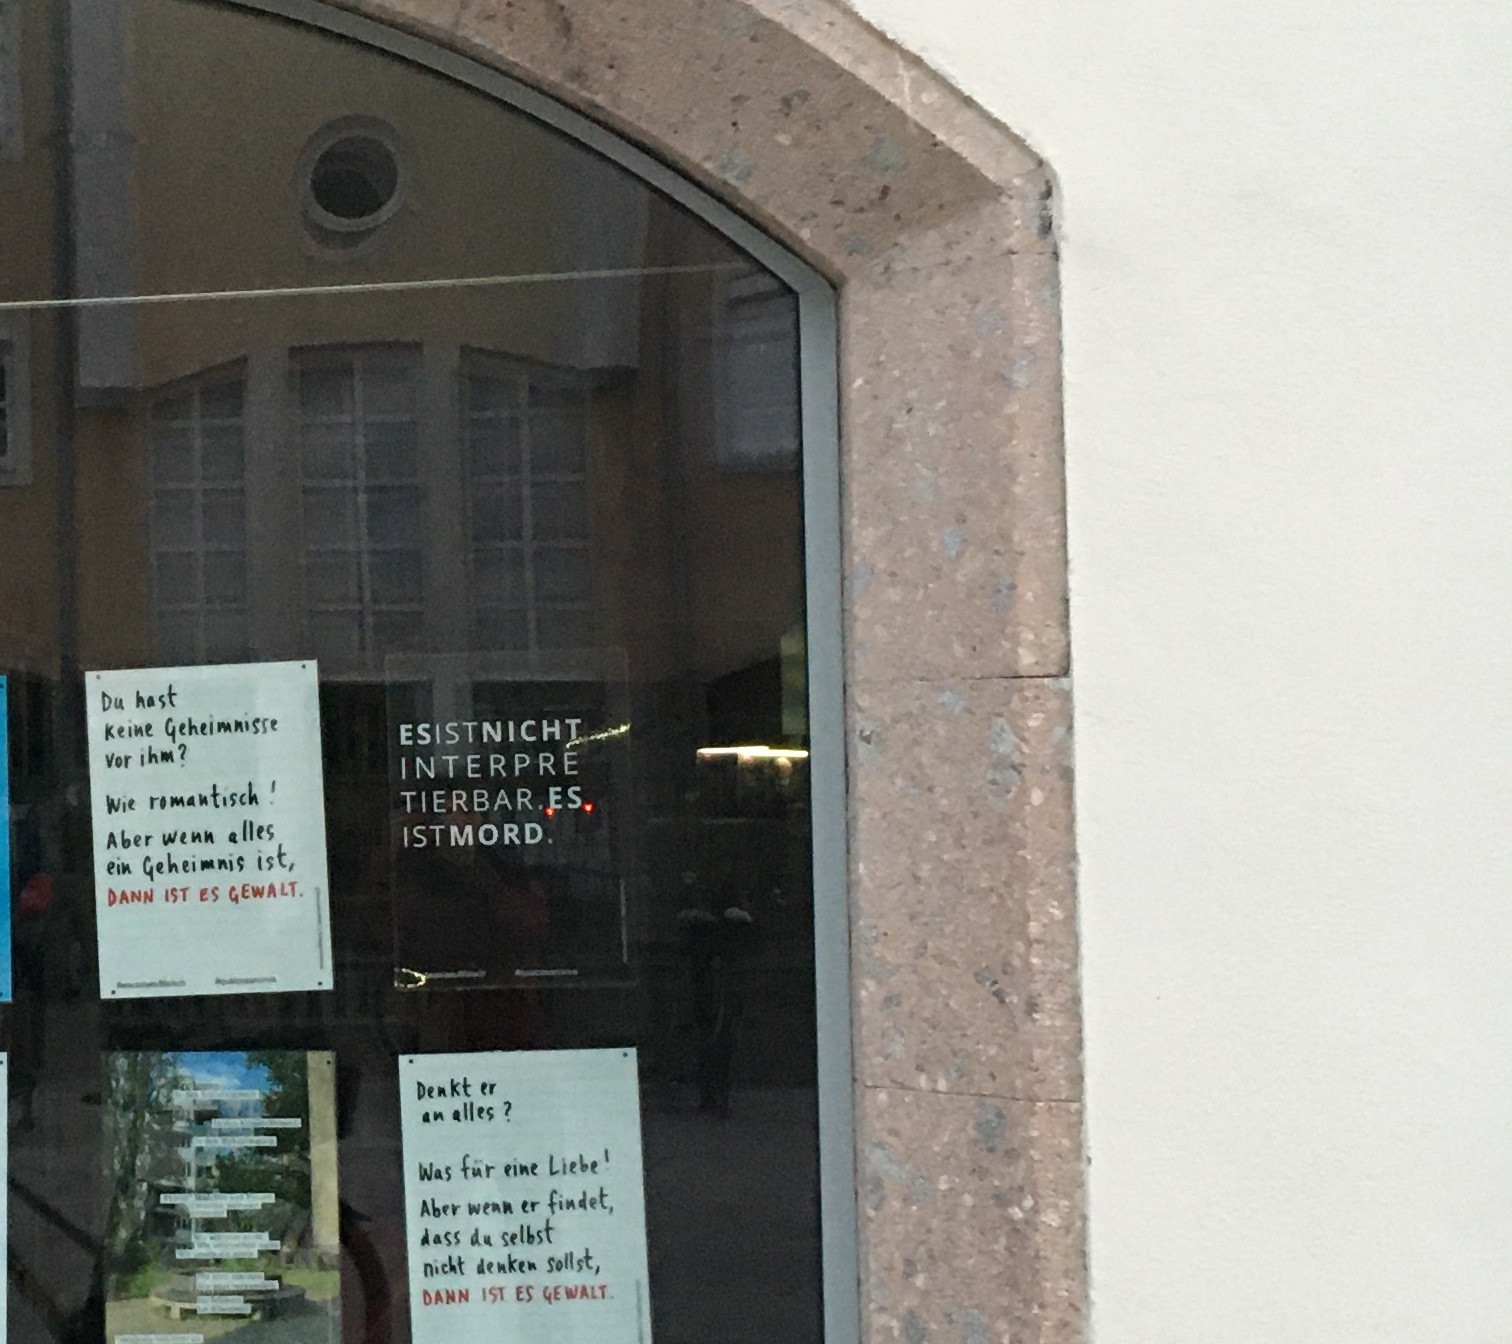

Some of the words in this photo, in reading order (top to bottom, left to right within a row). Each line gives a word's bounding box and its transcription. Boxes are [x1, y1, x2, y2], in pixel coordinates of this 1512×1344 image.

[101, 689, 126, 713] Du
[135, 684, 178, 708] hast
[104, 717, 158, 741] keine
[164, 712, 281, 739] Geheimnisse
[104, 751, 132, 770] vor
[139, 743, 189, 768] ihm?
[400, 752, 581, 781] INTERPRE
[105, 793, 137, 815] Wie
[106, 827, 154, 851] Aber
[161, 826, 215, 846] wenn
[229, 820, 276, 843] alles
[105, 856, 133, 877] ein
[142, 852, 246, 876] Geheimnis
[257, 844, 296, 873] ist,
[106, 886, 156, 907] DANN
[164, 884, 190, 904] IST
[199, 882, 221, 903] ES
[227, 879, 304, 904] GEWALT.
[416, 1076, 473, 1101] Denkt
[480, 1080, 497, 1096] er
[422, 1109, 445, 1124] an
[418, 1160, 453, 1182] Was
[460, 1152, 496, 1181] für
[503, 1157, 539, 1178] eine
[419, 1197, 462, 1219] Aber
[467, 1199, 515, 1216] wenn
[521, 1198, 540, 1215] er
[549, 1187, 615, 1216] findet,
[420, 1227, 462, 1248] dass
[469, 1225, 494, 1248] du
[501, 1218, 556, 1246] selbst
[423, 1255, 466, 1278] nicht
[476, 1254, 539, 1276] denken
[546, 1251, 602, 1276] sollst,
[422, 1287, 470, 1307] DANN
[481, 1285, 507, 1304] IST
[515, 1284, 535, 1303] ES
[542, 1282, 615, 1304] GEWALT.
